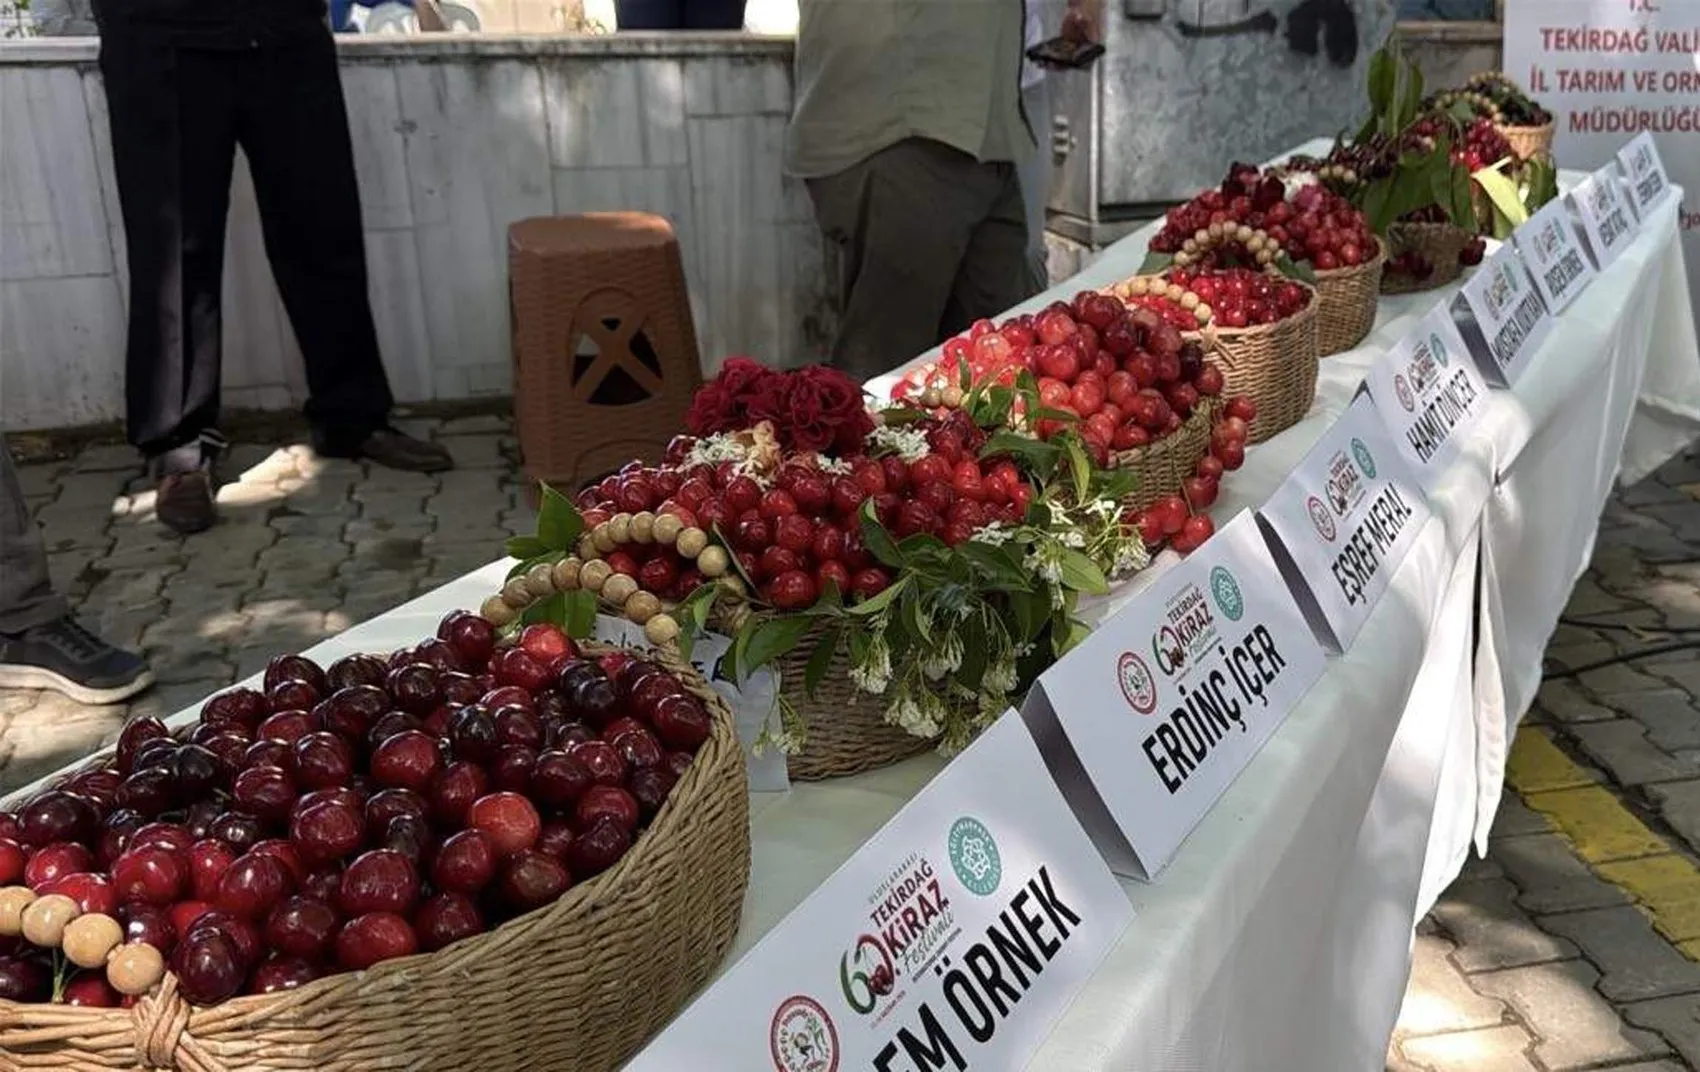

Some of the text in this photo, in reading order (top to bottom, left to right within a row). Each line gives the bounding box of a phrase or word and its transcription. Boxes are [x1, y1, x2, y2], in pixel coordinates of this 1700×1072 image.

[1540, 25, 1649, 52] TEKİRDAĞ
[1530, 65, 1549, 93] İL
[1556, 69, 1625, 93] TARIM
[1633, 70, 1657, 93] VE
[1406, 400, 1450, 464] HAMİT
[1331, 482, 1412, 606] EŞREF MERAL
[1141, 624, 1287, 795] ERDİNÇ İÇER
[870, 858, 934, 929] TEKİRDAĞ
[881, 878, 950, 960] KİRAZ
[934, 864, 1082, 1045] ÖRNEK
